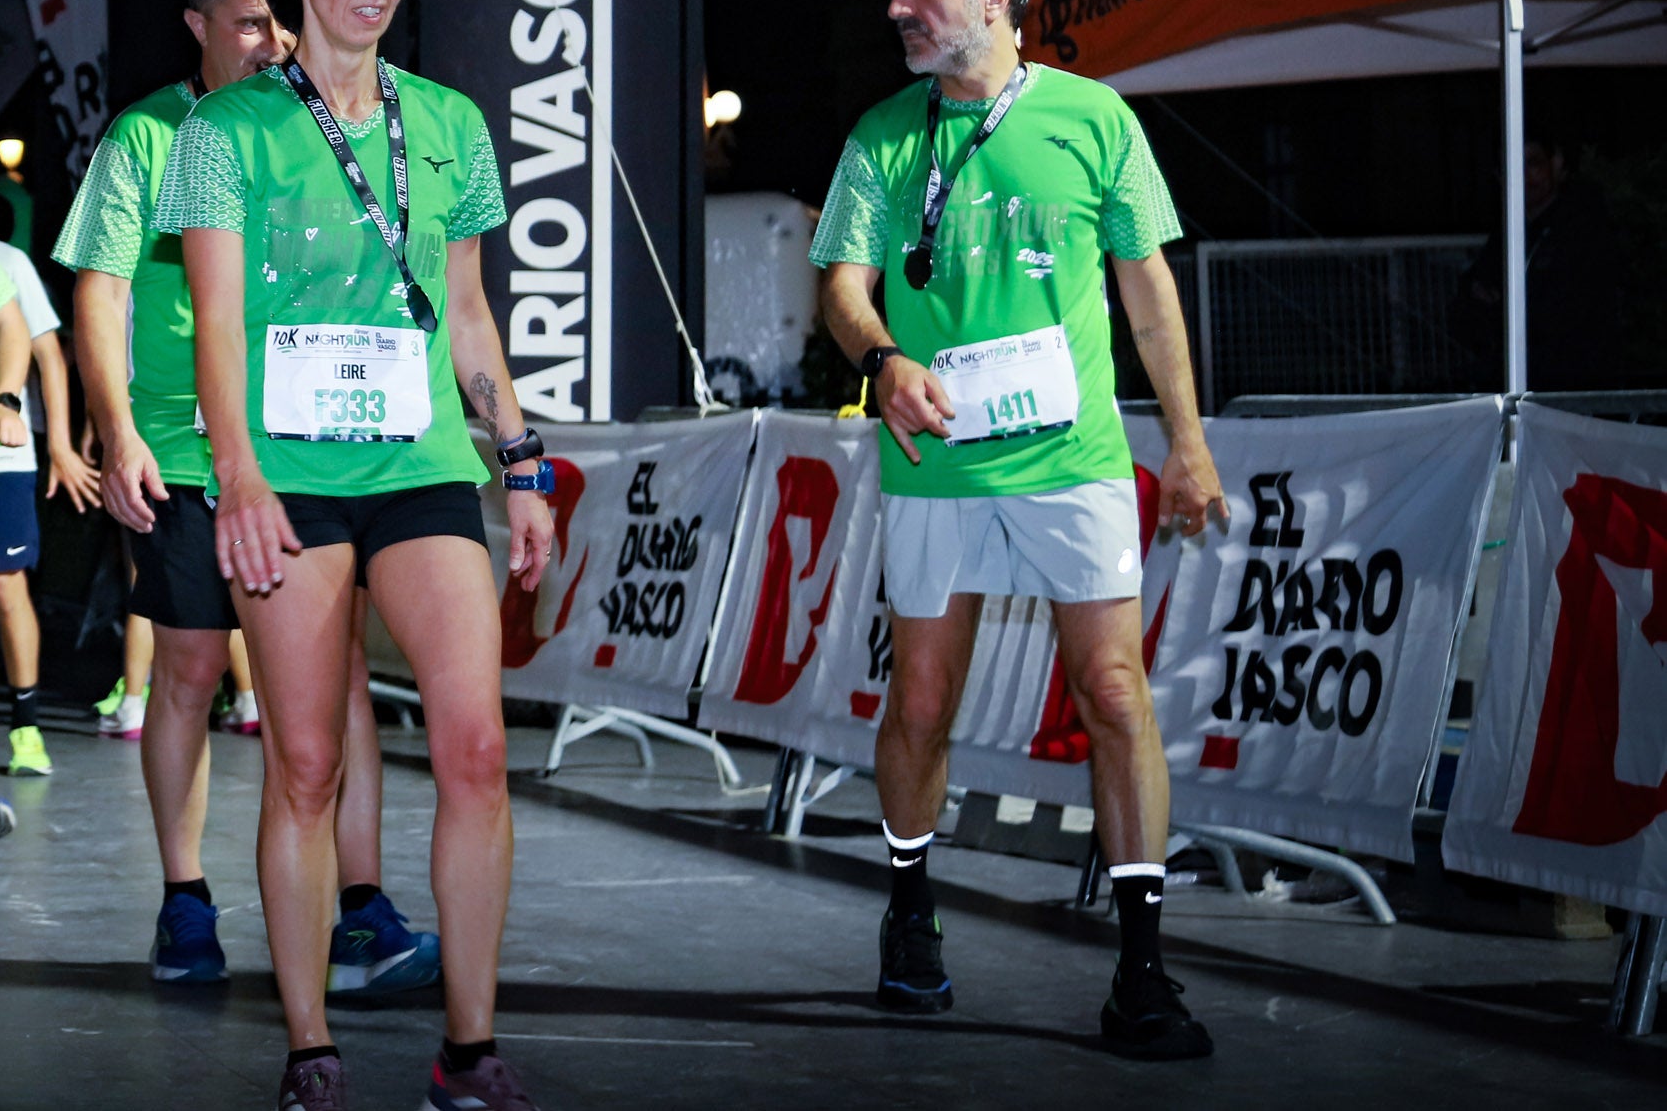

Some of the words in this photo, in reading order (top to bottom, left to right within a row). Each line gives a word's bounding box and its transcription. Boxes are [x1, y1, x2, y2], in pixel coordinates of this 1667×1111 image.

[307, 98, 344, 145] FINISHER
[984, 91, 1013, 133] FINISHER
[392, 157, 408, 209] FINISHER
[273, 327, 300, 349] 10K
[411, 341, 420, 356] 3
[1055, 336, 1062, 348] 2
[335, 364, 367, 380] LEIRE
[314, 389, 386, 423] F333
[982, 389, 1038, 425] 1411
[626, 461, 659, 515] EL
[1248, 470, 1305, 548] EL
